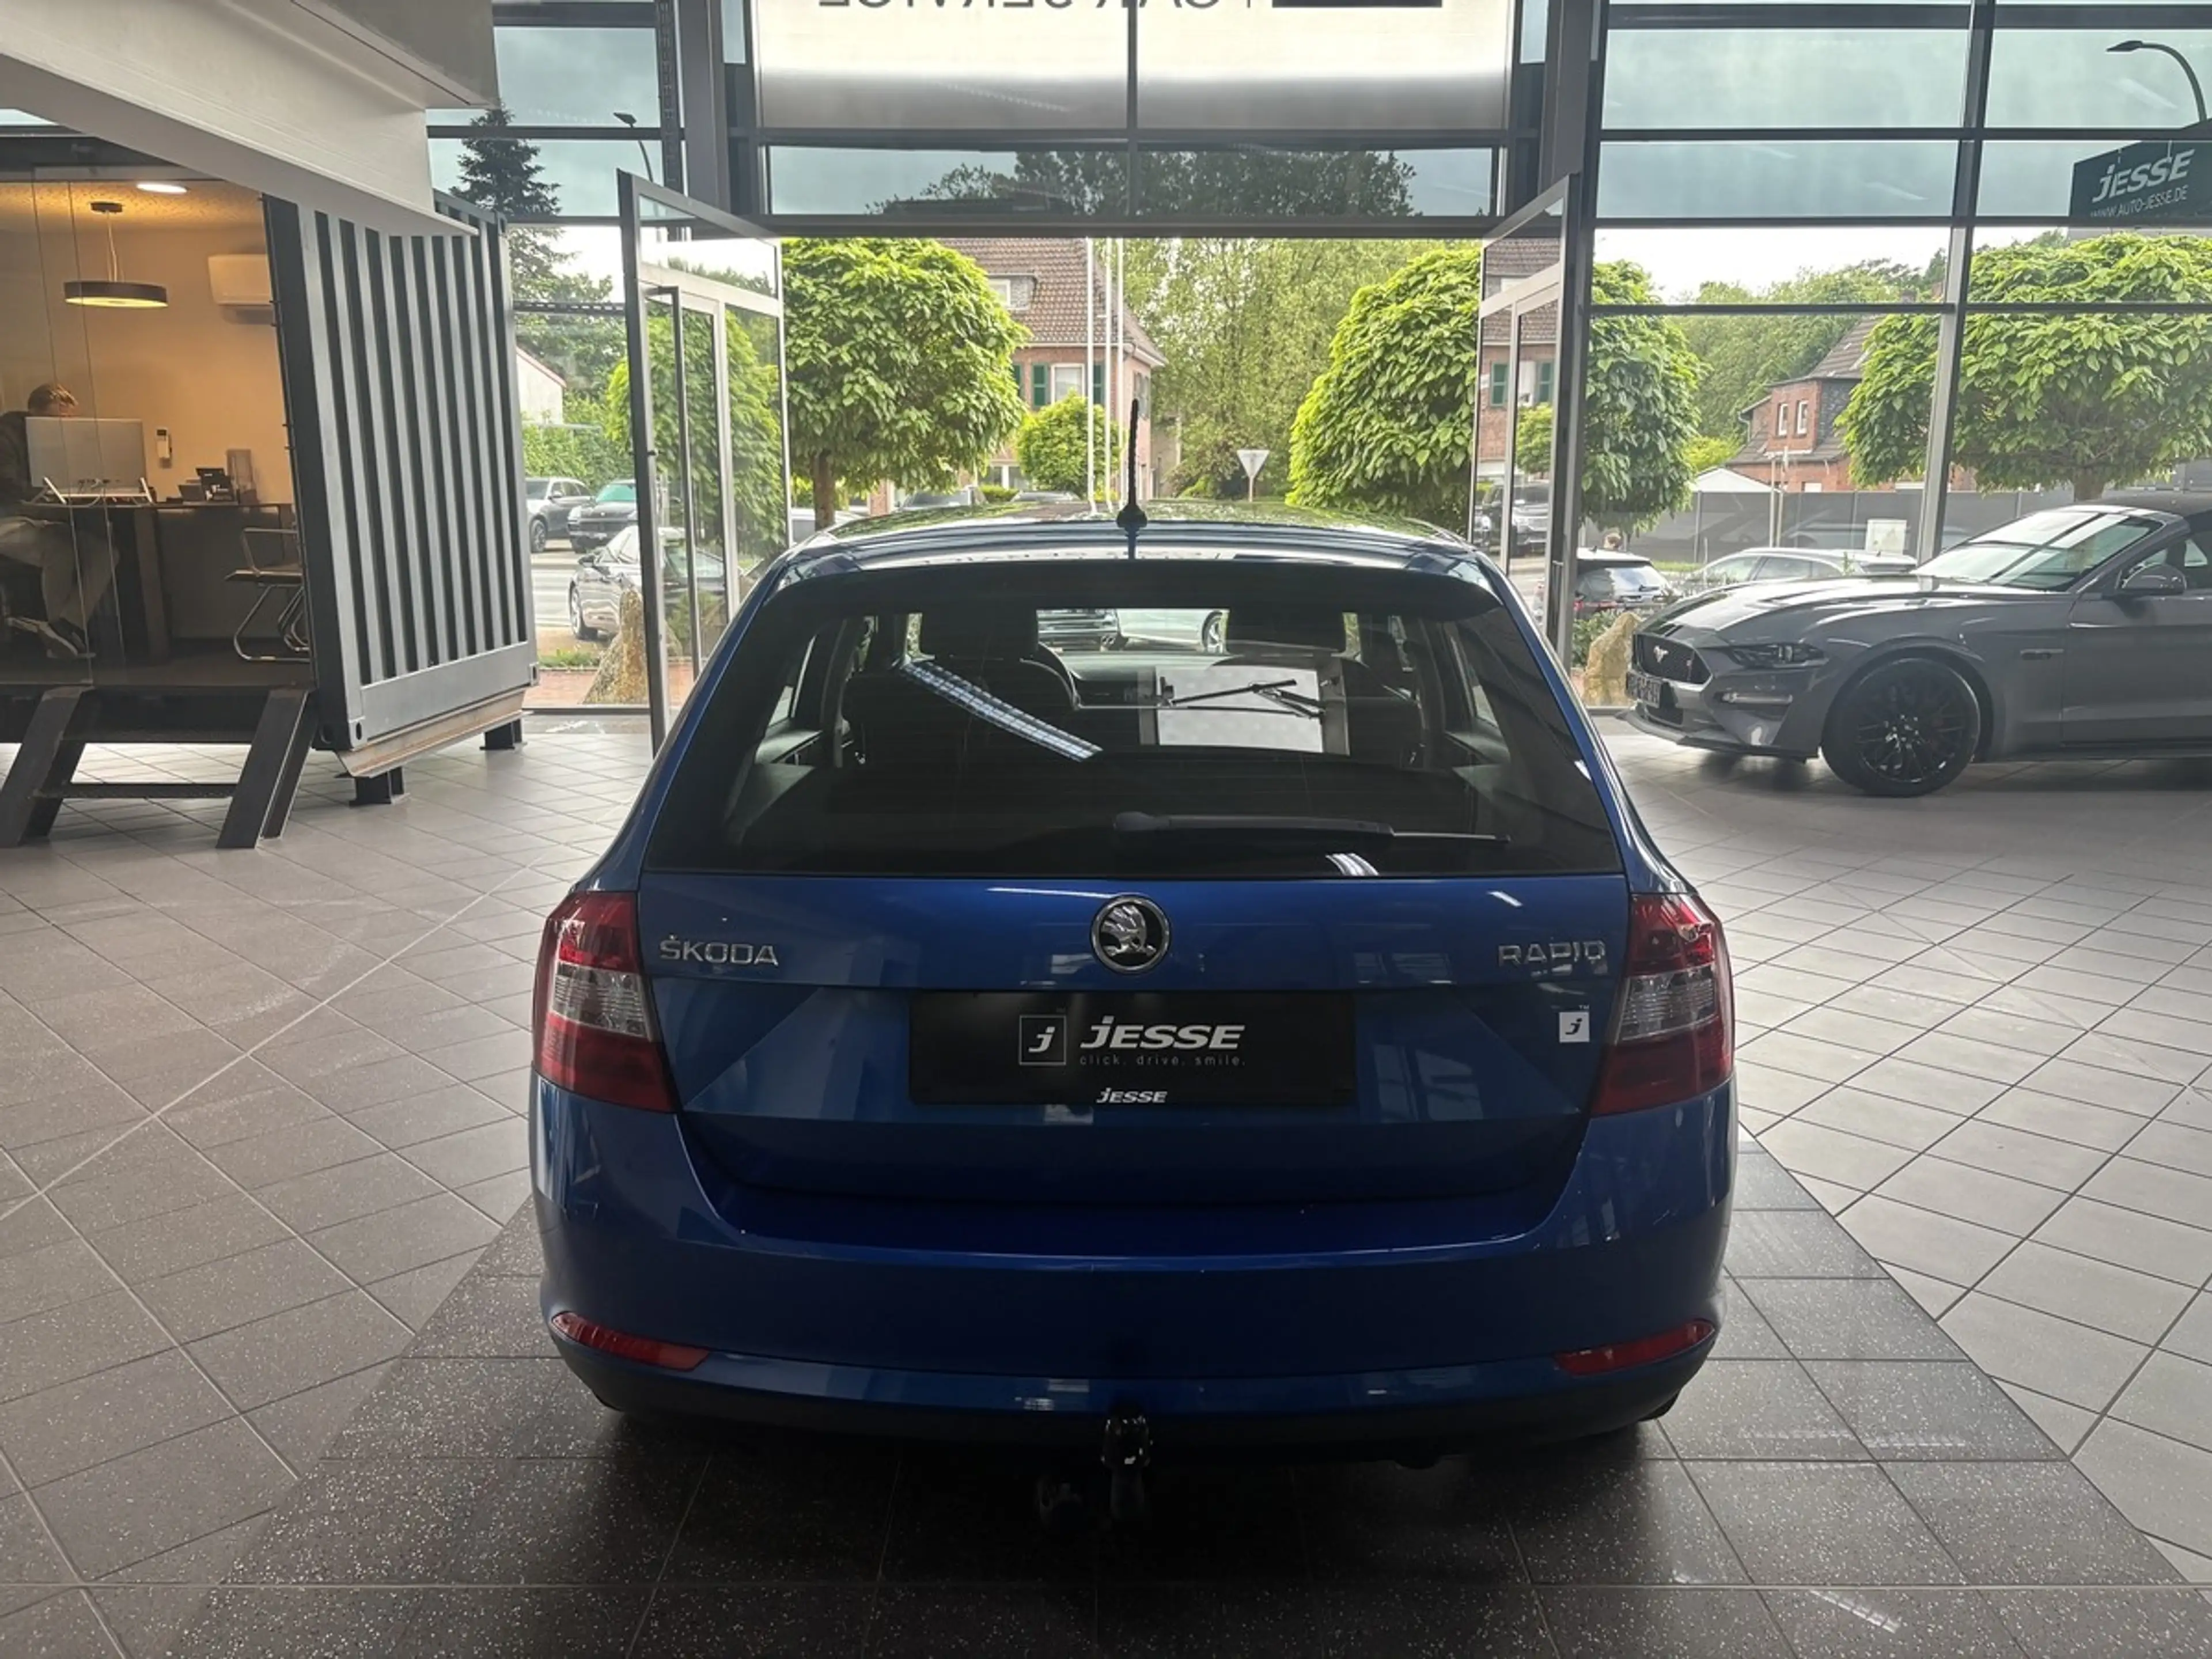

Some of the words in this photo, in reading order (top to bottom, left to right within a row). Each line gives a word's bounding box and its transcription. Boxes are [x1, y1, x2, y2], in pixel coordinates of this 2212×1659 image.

[660, 934, 779, 966] ŠKODA
[1498, 940, 1606, 966] RAPID
[1194, 1054, 1245, 1066] smile.
